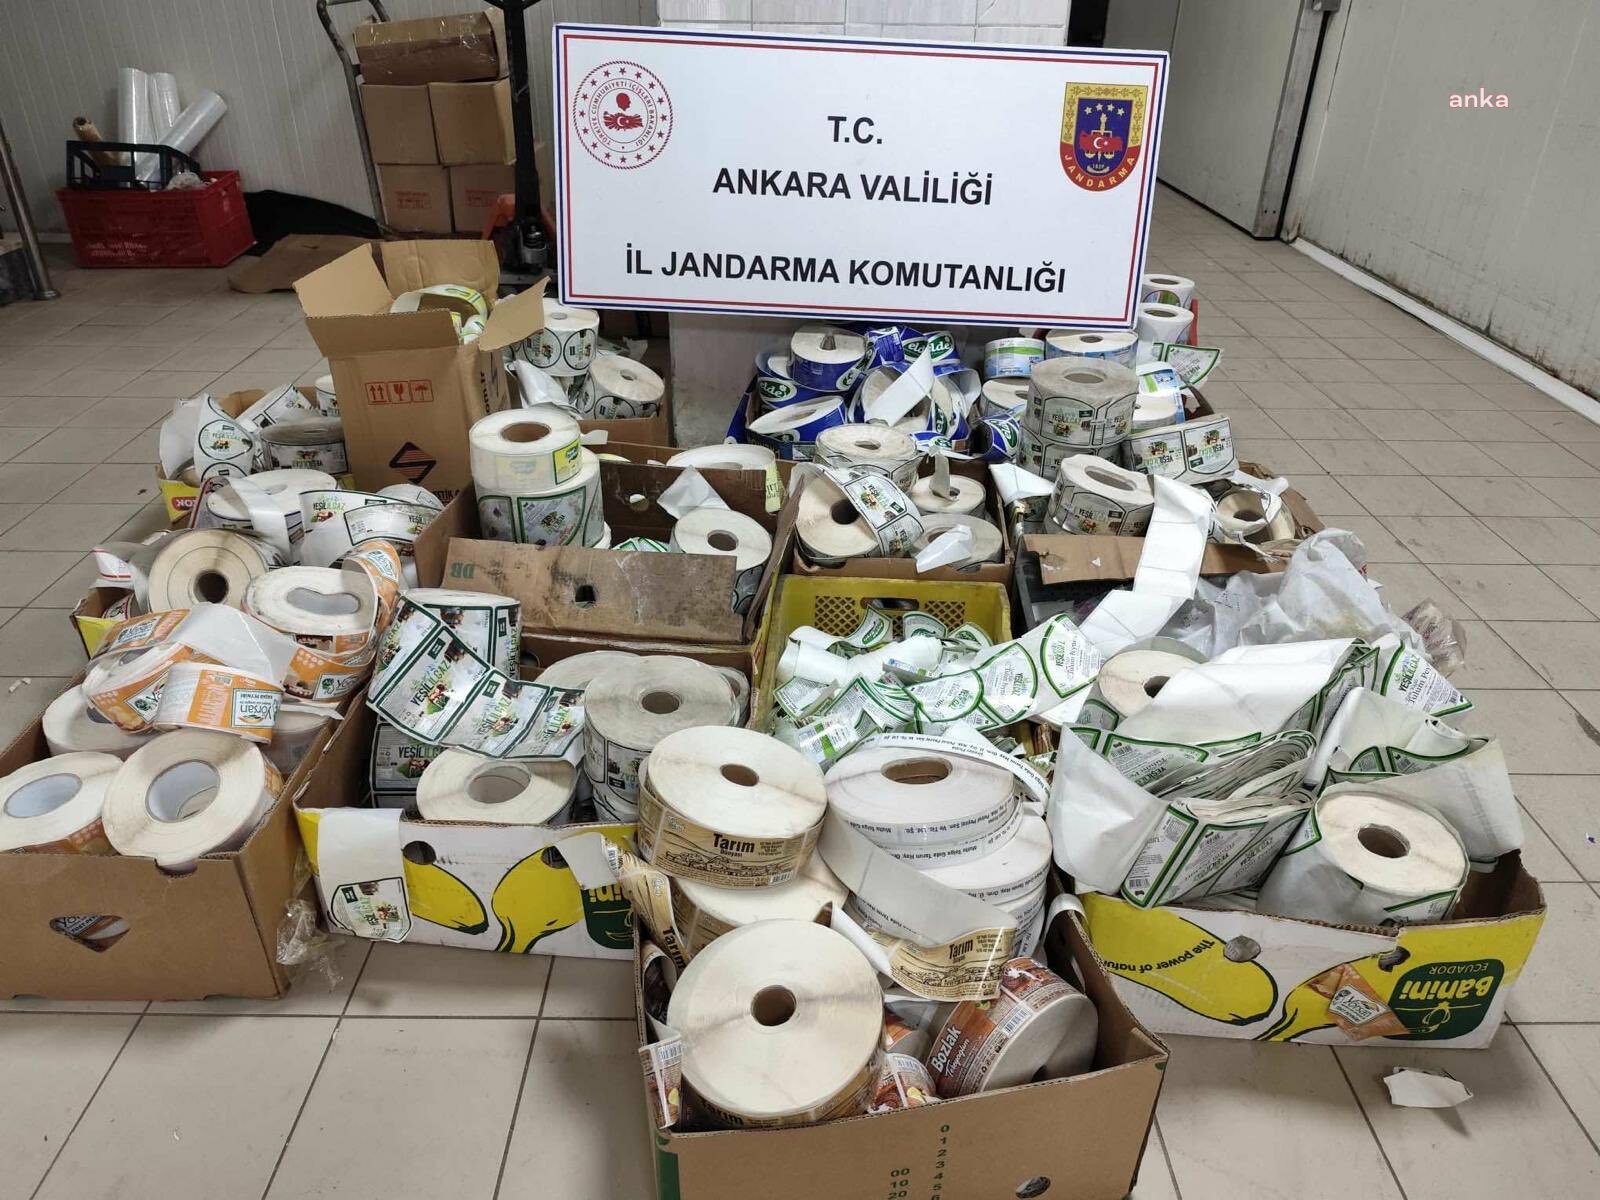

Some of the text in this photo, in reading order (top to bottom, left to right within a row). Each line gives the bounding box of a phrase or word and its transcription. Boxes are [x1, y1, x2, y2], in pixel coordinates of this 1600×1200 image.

[827, 116, 883, 144] T.C.
[1065, 154, 1135, 188] JANDARMA
[712, 167, 993, 205] ANKARA VALİLİĞİ
[626, 243, 1067, 294] İL JANDARMA KOMUTANLIĞI
[240, 705, 272, 720] Yörsan
[713, 832, 755, 853] Tarım
[949, 939, 974, 959] Tarım
[1192, 938, 1216, 955] The
[1138, 964, 1153, 974] of
[1155, 949, 1194, 971] power
[1428, 962, 1489, 975] ECUADOR
[1398, 975, 1495, 1001] Banini
[931, 1025, 961, 1073] Bozlak
[940, 1136, 946, 1144] 1
[937, 1149, 947, 1157] 2
[936, 1160, 945, 1168] 3
[934, 1172, 944, 1180] 4
